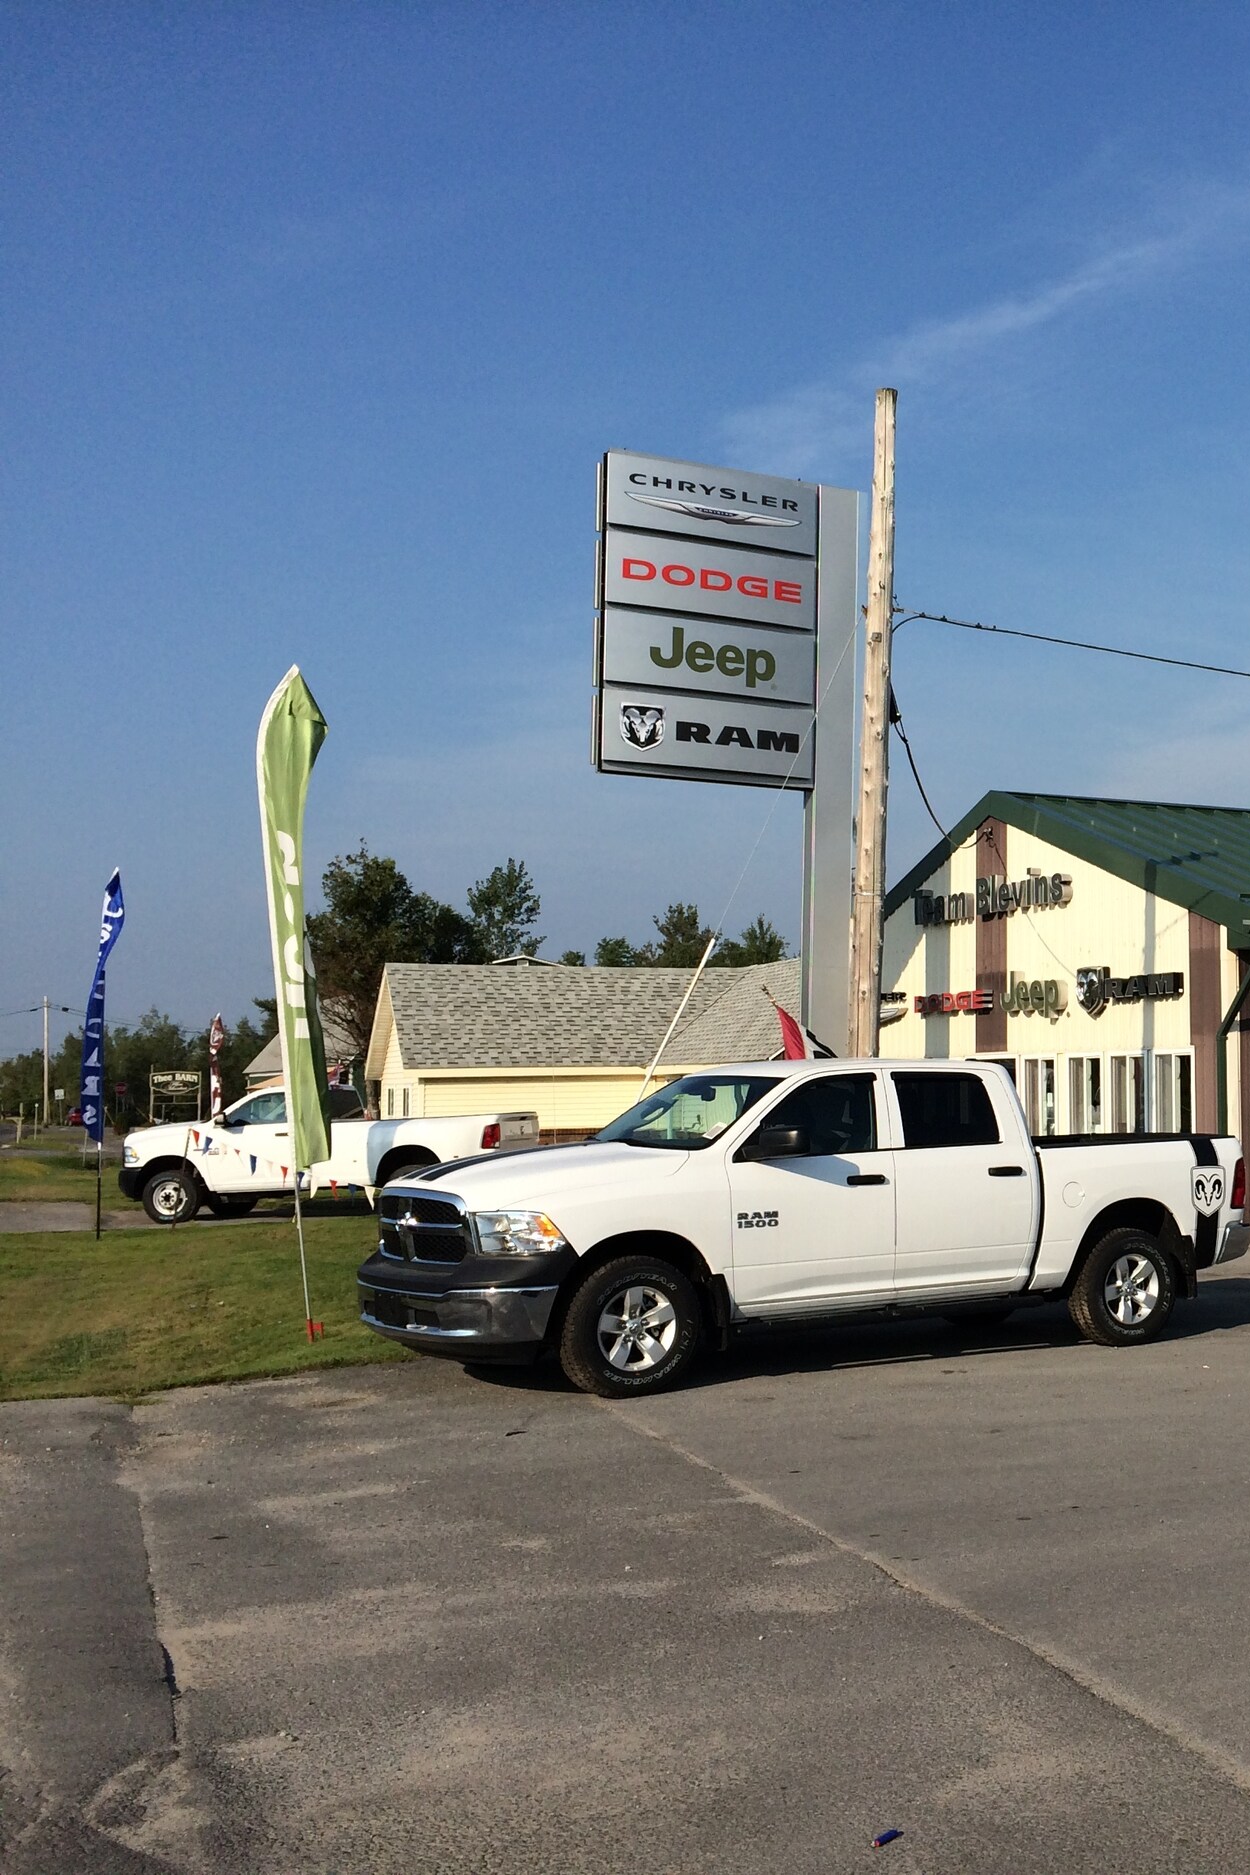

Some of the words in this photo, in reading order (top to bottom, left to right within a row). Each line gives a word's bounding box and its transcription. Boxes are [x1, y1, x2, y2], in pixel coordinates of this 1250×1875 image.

[628, 473, 799, 512] CHRYSLER
[622, 557, 802, 604] DODGE
[649, 626, 776, 688] Jeep
[675, 720, 800, 753] RAM
[911, 889, 974, 925] Team
[976, 867, 1073, 915] Blevins
[914, 989, 994, 1013] DODGE
[1000, 971, 1068, 1019] Jeep
[1105, 972, 1184, 1000] RAM
[175, 1074, 198, 1082] BARN
[737, 1211, 779, 1220] RAM
[737, 1219, 779, 1229] 1500
